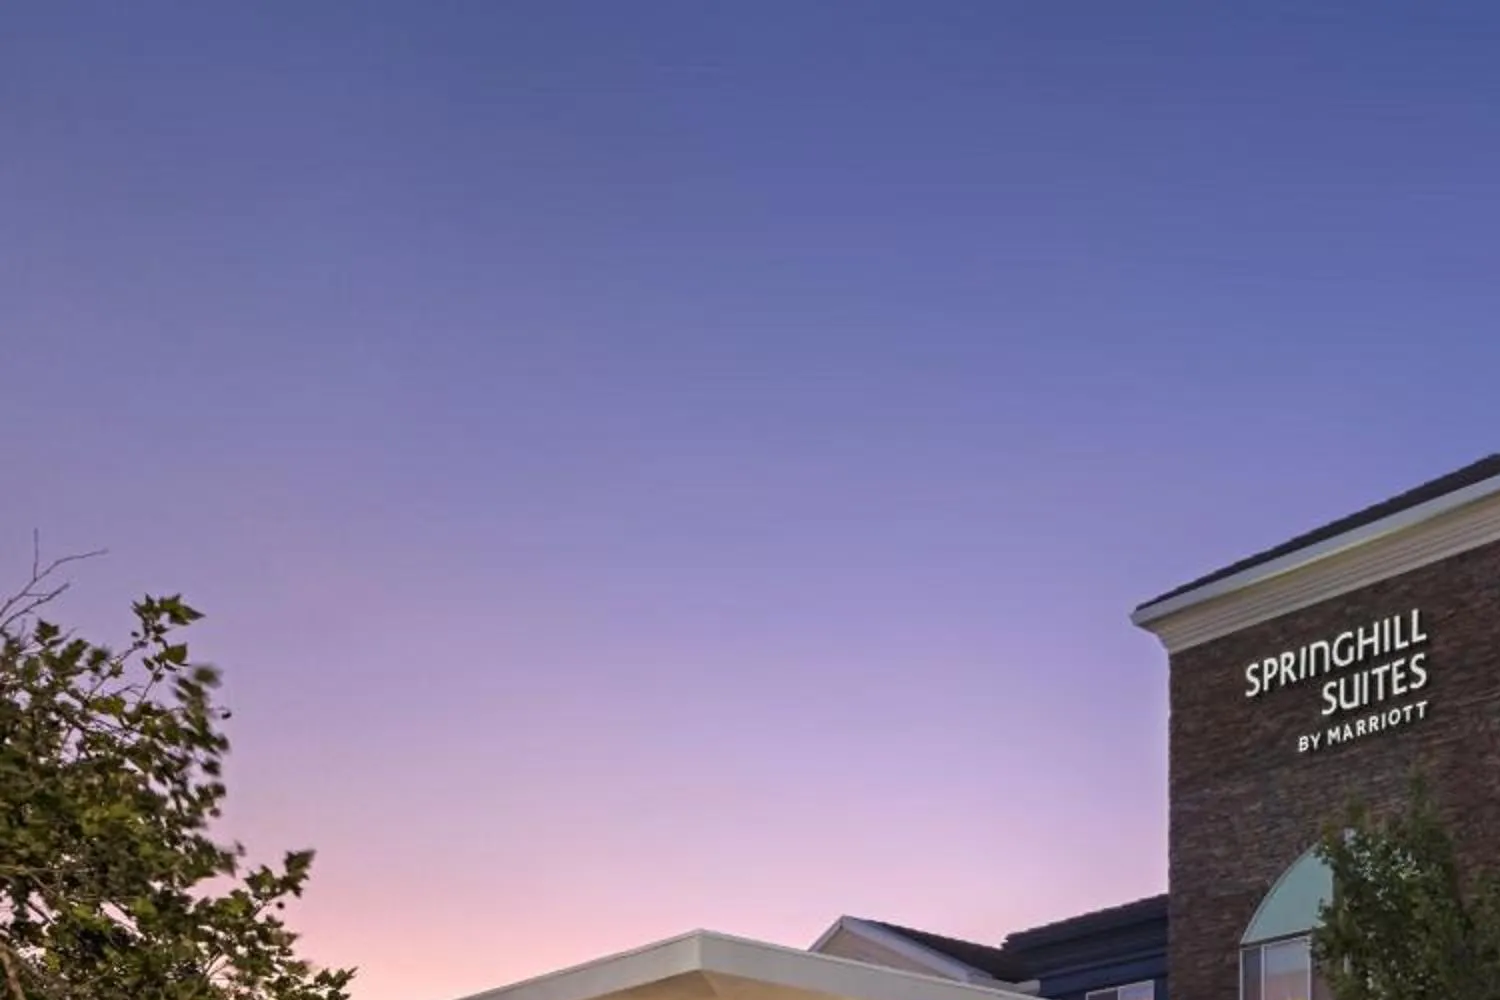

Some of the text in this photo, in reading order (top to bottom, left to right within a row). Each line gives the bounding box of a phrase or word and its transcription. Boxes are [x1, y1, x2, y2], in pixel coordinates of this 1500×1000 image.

[1245, 608, 1427, 697] SPRINGHILL
[1321, 652, 1428, 715] SUITES
[1298, 701, 1428, 752] BY MARRIOTT
